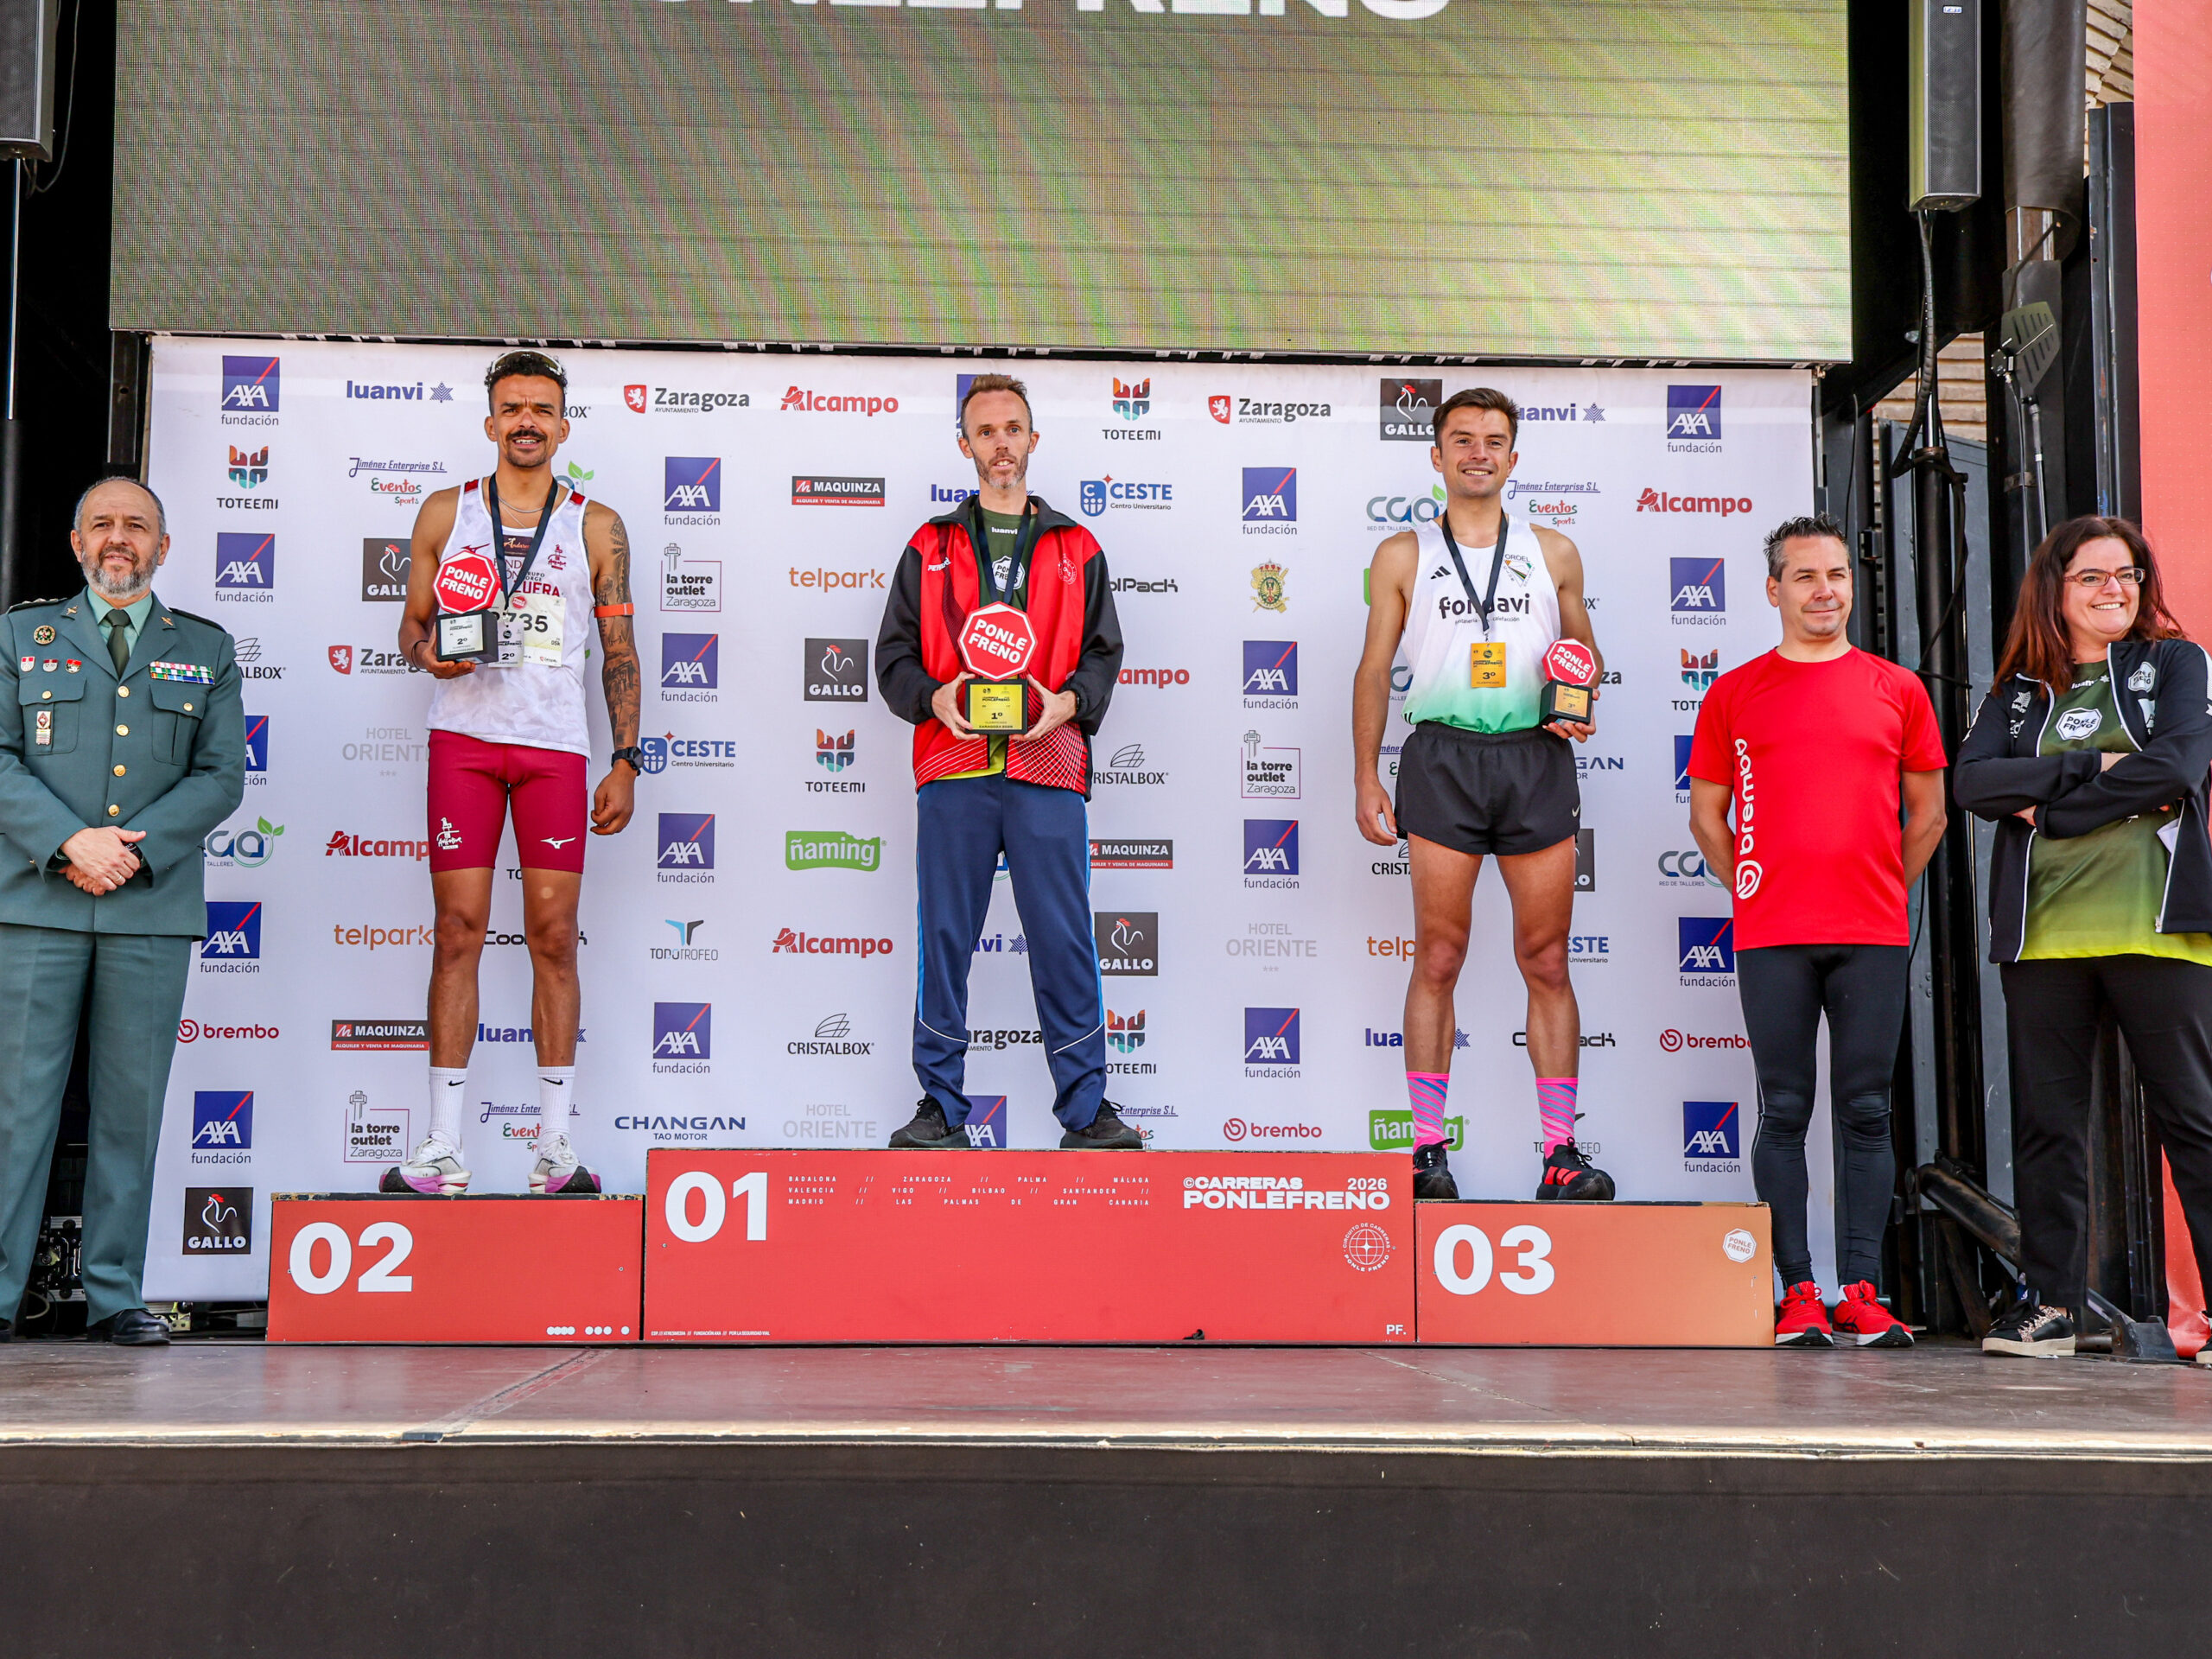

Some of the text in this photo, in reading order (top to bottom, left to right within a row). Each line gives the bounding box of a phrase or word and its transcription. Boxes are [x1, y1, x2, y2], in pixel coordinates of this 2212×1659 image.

[221, 384, 270, 407] AXA
[346, 380, 423, 400] luanvi
[654, 386, 750, 413] Zaragoza
[779, 385, 899, 417] Alcampo
[1238, 397, 1332, 423] Zaragoza
[220, 413, 279, 426] fundación
[1667, 412, 1712, 435] AXA
[1102, 429, 1161, 441] TOTEEMI
[1384, 423, 1436, 435] GALLO
[1666, 442, 1723, 454] fundación
[388, 460, 430, 473] Enterprise
[371, 477, 422, 493] Eventos
[813, 480, 881, 495] MAQUINZA
[1109, 482, 1173, 501] CESTE
[1544, 481, 1585, 493] Enterprise
[216, 497, 279, 510] TOTEEMI
[394, 496, 419, 506] Sports
[664, 485, 709, 508] AXA
[1636, 487, 1753, 517] Alcampo
[1133, 502, 1172, 511] Universitario
[1243, 494, 1287, 517] AXA
[1529, 499, 1578, 515] Eventos
[664, 514, 721, 526] fundación
[1552, 517, 1576, 527] Sports
[991, 526, 1018, 535] luanvi
[1243, 524, 1297, 536] fundación
[216, 561, 263, 584] AXA
[444, 565, 489, 589] PONLE
[666, 574, 713, 585] la torre
[789, 567, 886, 593] telpark
[440, 578, 484, 600] FRENO
[665, 584, 706, 596] outlet
[1670, 584, 1717, 607] AXA
[215, 591, 274, 603] fundación
[665, 596, 716, 609] Zaragoza
[1670, 614, 1726, 626] fundación
[974, 619, 1028, 652] PONLE
[968, 632, 1021, 664] FRENO
[1556, 645, 1592, 672] PONLE
[661, 661, 707, 684] AXA
[1552, 653, 1587, 680] FRENO
[1243, 667, 1287, 690] AXA
[660, 690, 718, 703] fundación
[809, 683, 863, 696] GALLO
[1243, 697, 1299, 709] fundación
[366, 728, 412, 741] HOTEL
[671, 740, 736, 759] CESTE
[1247, 760, 1293, 772] la torre
[1247, 772, 1285, 783] outlet
[804, 781, 866, 793] TOTEEMI
[1247, 783, 1296, 795] Zaragoza
[1734, 738, 1755, 855] brembo
[325, 830, 429, 862] Alcamp
[790, 836, 875, 868] ñaming
[1102, 844, 1169, 855] MAQUINZA
[658, 842, 704, 865] AXA
[1244, 847, 1287, 870] AXA
[657, 871, 715, 884] fundación
[1243, 878, 1300, 890] fundación
[1248, 923, 1293, 936] HOTEL
[200, 931, 251, 955] AXA
[334, 924, 434, 950] telpark
[772, 927, 893, 959] Alcampo
[650, 948, 719, 961] TODOTROFEO
[1226, 938, 1318, 957] ORIENTE
[1679, 944, 1724, 968] AXA
[200, 962, 261, 975] fundación
[1098, 957, 1154, 970] GALLO
[1679, 976, 1736, 988] fundación
[203, 1024, 280, 1040] brembo
[354, 1024, 426, 1038] MAQUINZA
[653, 1030, 700, 1054] AXA
[787, 1042, 871, 1055] CRISTALBOX
[1244, 1035, 1291, 1058] AXA
[652, 1062, 711, 1074] fundación
[1244, 1066, 1301, 1079] fundación
[806, 1103, 851, 1117] HOTEL
[350, 1122, 400, 1135] la torre
[614, 1116, 747, 1131] CHANGAN
[783, 1120, 877, 1141] ORIENTE
[1250, 1122, 1322, 1139] brembo
[193, 1121, 241, 1144] AXA
[653, 1132, 708, 1141] TAO MOTOR
[350, 1135, 392, 1146] outlet
[1683, 1130, 1728, 1154] AXA
[190, 1152, 251, 1164] fundación
[350, 1146, 403, 1159] Zaragoza
[1683, 1161, 1741, 1173] fundación
[1347, 1177, 1388, 1191] 2026
[664, 1171, 768, 1243] 01
[1183, 1190, 1390, 1211] PONLEFRENO
[188, 1236, 246, 1249] GALLO
[1342, 1224, 1360, 1249] CIRCUITO
[1370, 1223, 1391, 1249] CARRERAS
[1728, 1236, 1752, 1249] PONLE
[1727, 1243, 1751, 1255] FRENO
[289, 1221, 414, 1295] 02
[1344, 1253, 1390, 1272] PONLE FRENO
[1433, 1224, 1555, 1295] 03
[1385, 1324, 1407, 1335] PF.
